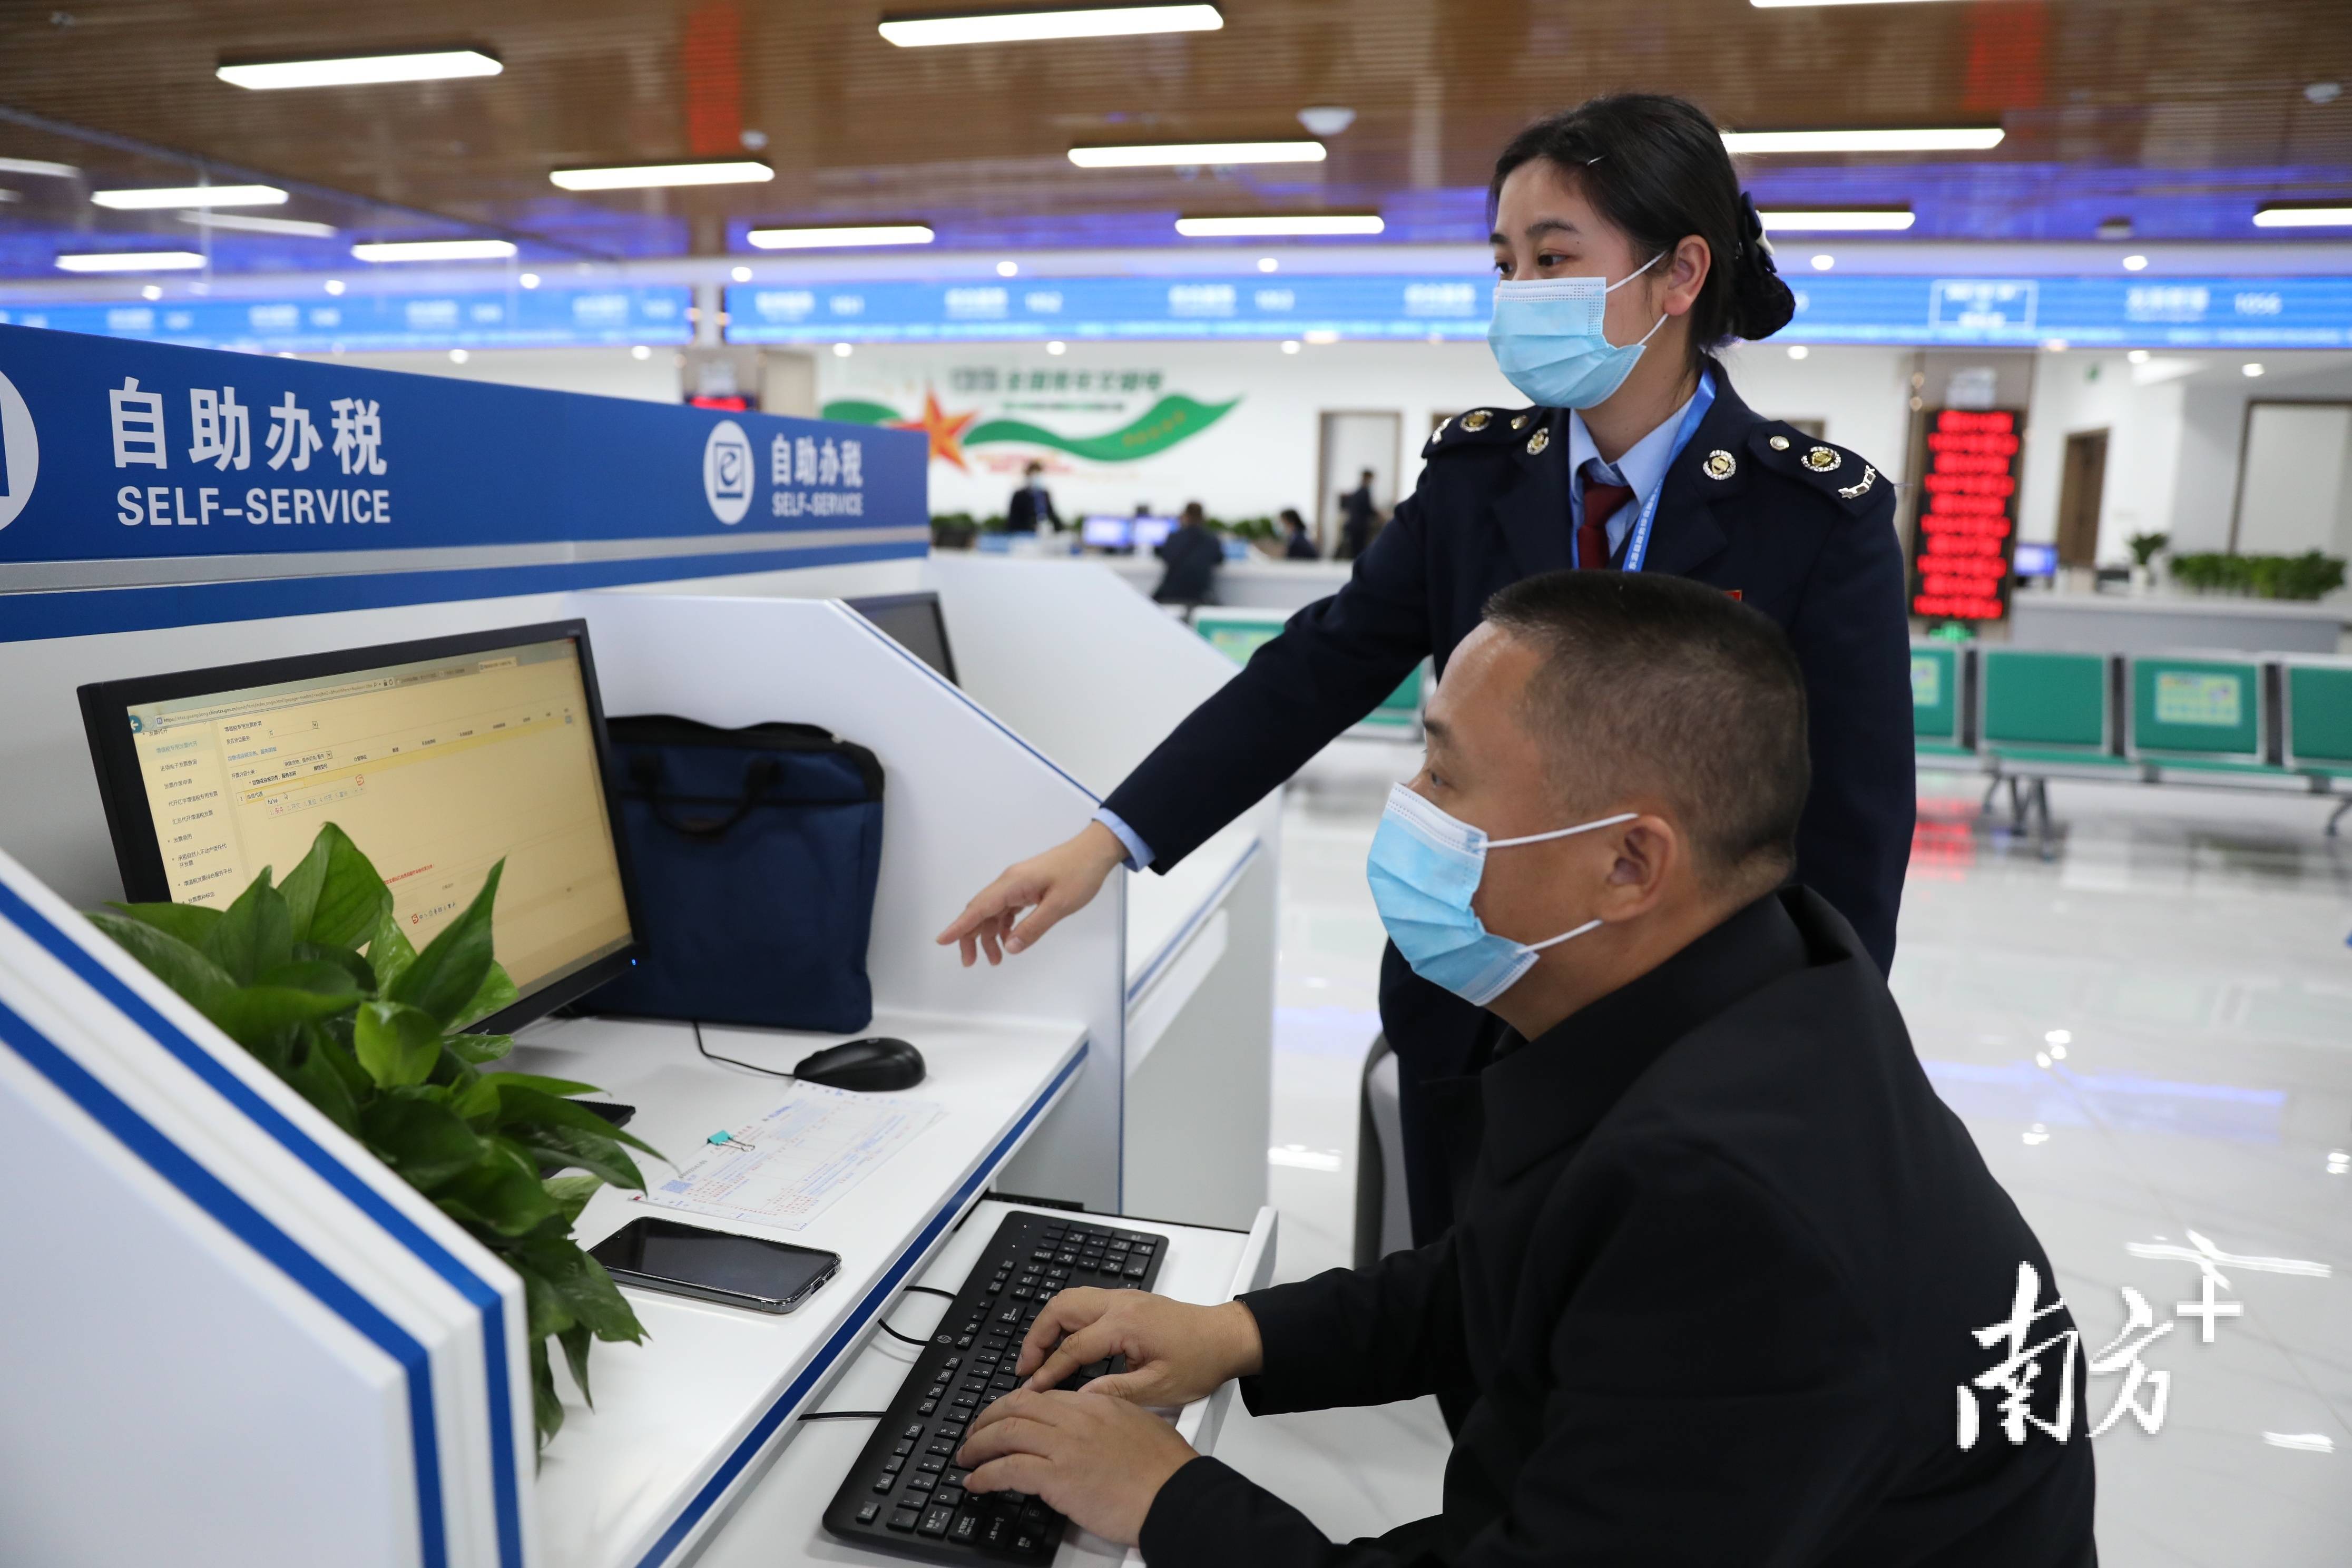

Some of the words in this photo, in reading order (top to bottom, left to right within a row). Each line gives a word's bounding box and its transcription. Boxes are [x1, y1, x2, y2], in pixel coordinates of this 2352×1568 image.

[109, 376, 388, 476] 自助办税
[771, 433, 864, 488] 自助办税
[117, 486, 391, 526] SELF-SERVICE
[772, 491, 864, 517] SELF-SERVICE
[149, 728, 168, 737] 发票代开
[180, 859, 193, 869] 开发票
